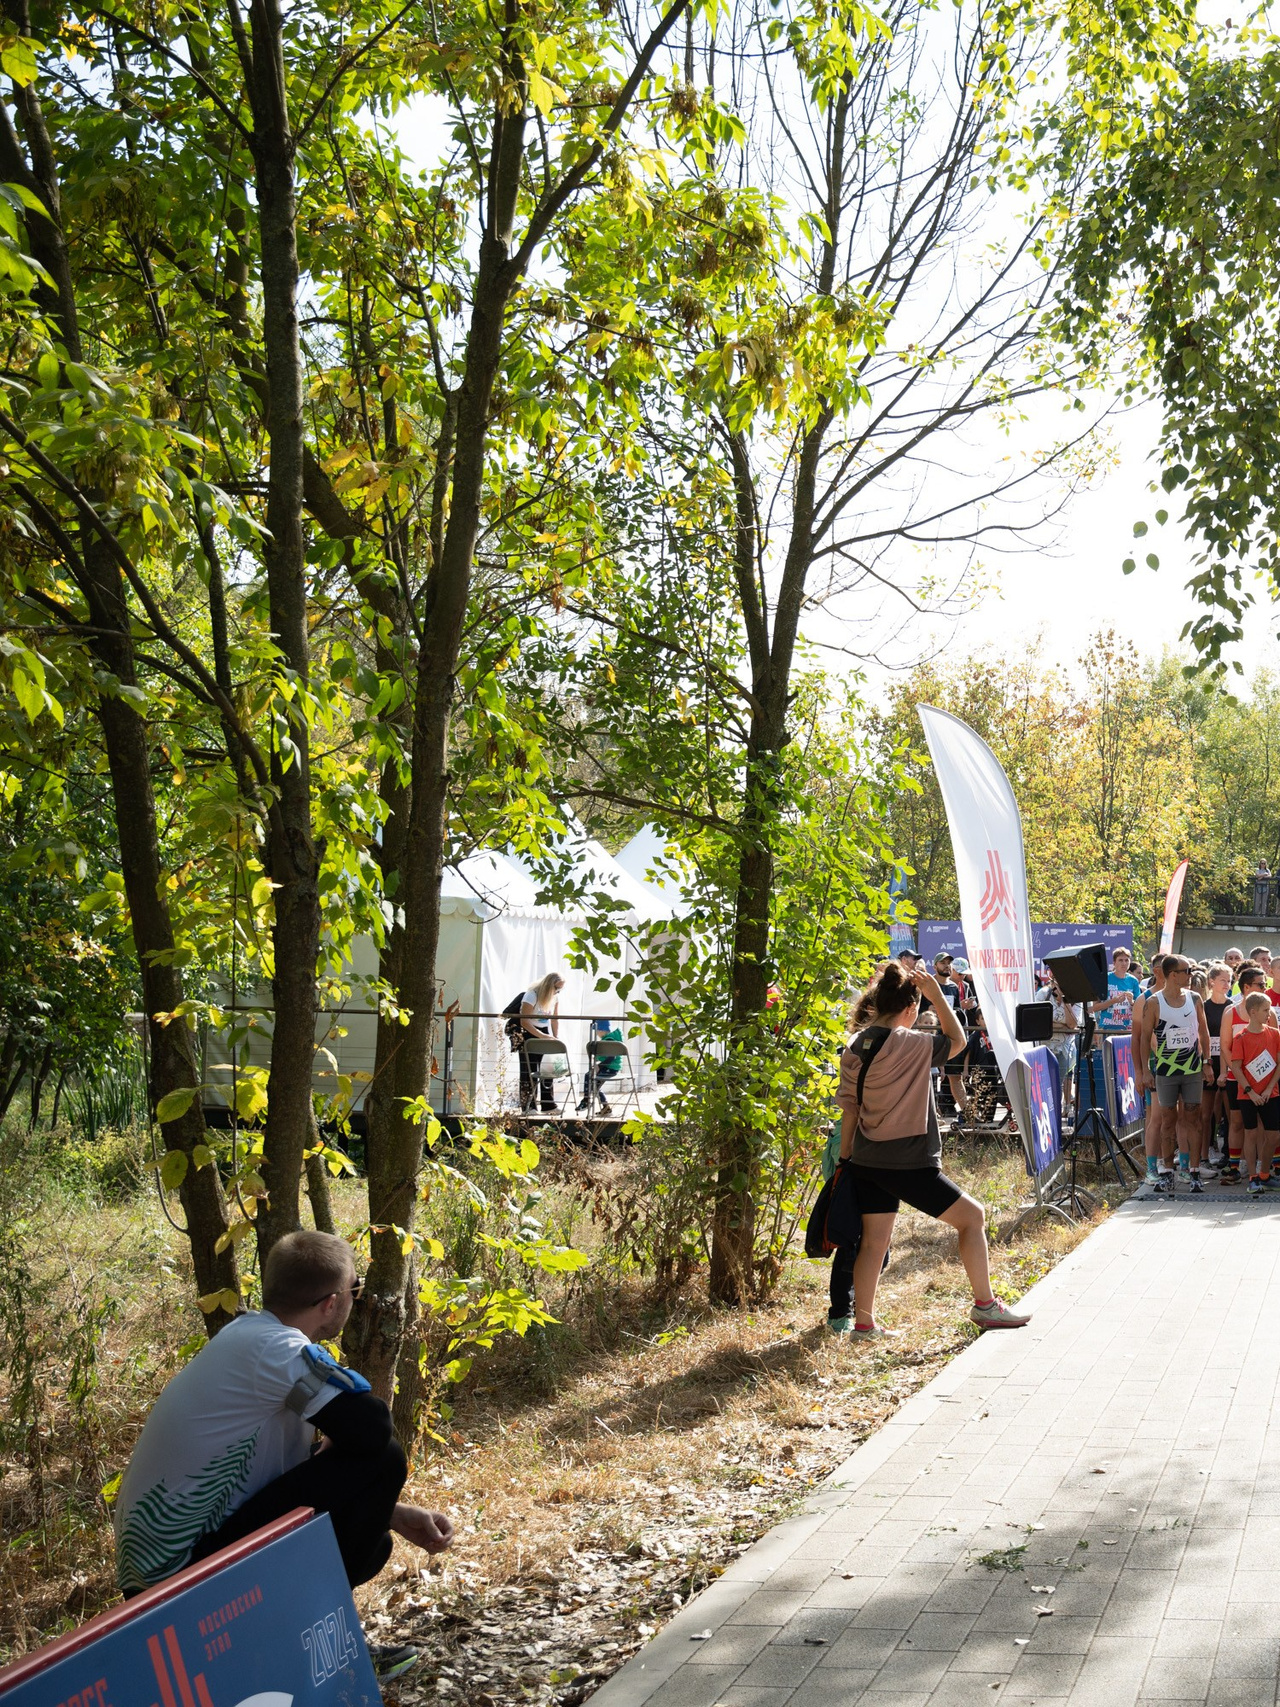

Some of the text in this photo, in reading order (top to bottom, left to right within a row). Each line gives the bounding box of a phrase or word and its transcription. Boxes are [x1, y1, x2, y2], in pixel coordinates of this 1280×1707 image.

[1256, 1060, 1272, 1076] 7241
[198, 1584, 263, 1637] МОСКОВСКИЙ
[205, 1632, 232, 1662] ЭТАП
[301, 1606, 359, 1688] 2024
